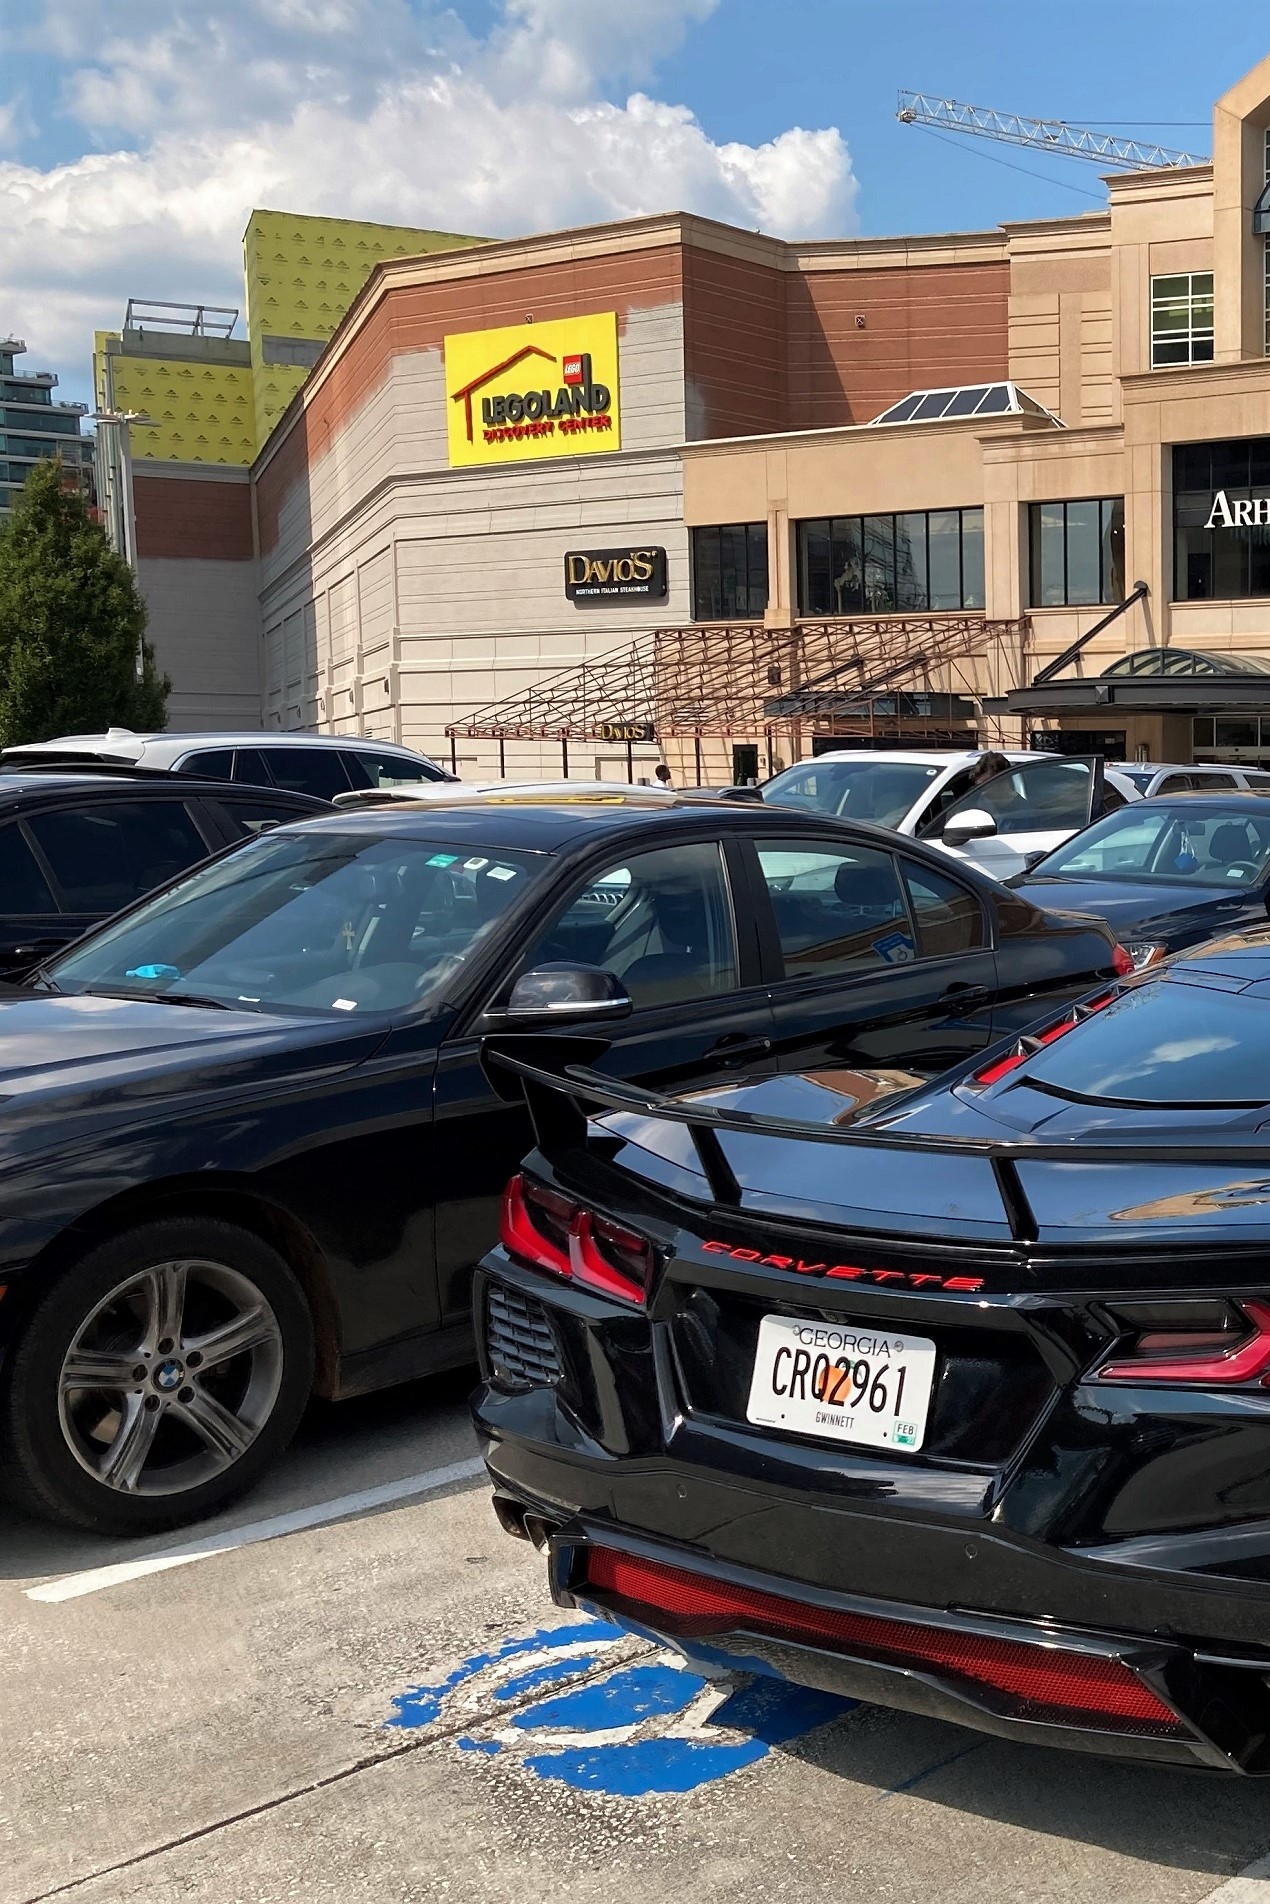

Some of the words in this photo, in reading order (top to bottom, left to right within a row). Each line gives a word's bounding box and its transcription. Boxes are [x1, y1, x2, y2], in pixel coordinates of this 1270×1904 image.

[565, 363, 581, 375] LEGO
[482, 375, 611, 424] LEGOLAND
[482, 421, 554, 440] DISCOVERY
[558, 415, 611, 431] CENTER
[702, 1240, 986, 1292] CORVETTE
[798, 1327, 892, 1358] GEORGIA
[772, 1346, 907, 1417] CRQ2961
[815, 1411, 855, 1429] GWINNETT
[897, 1423, 914, 1435] FEB
